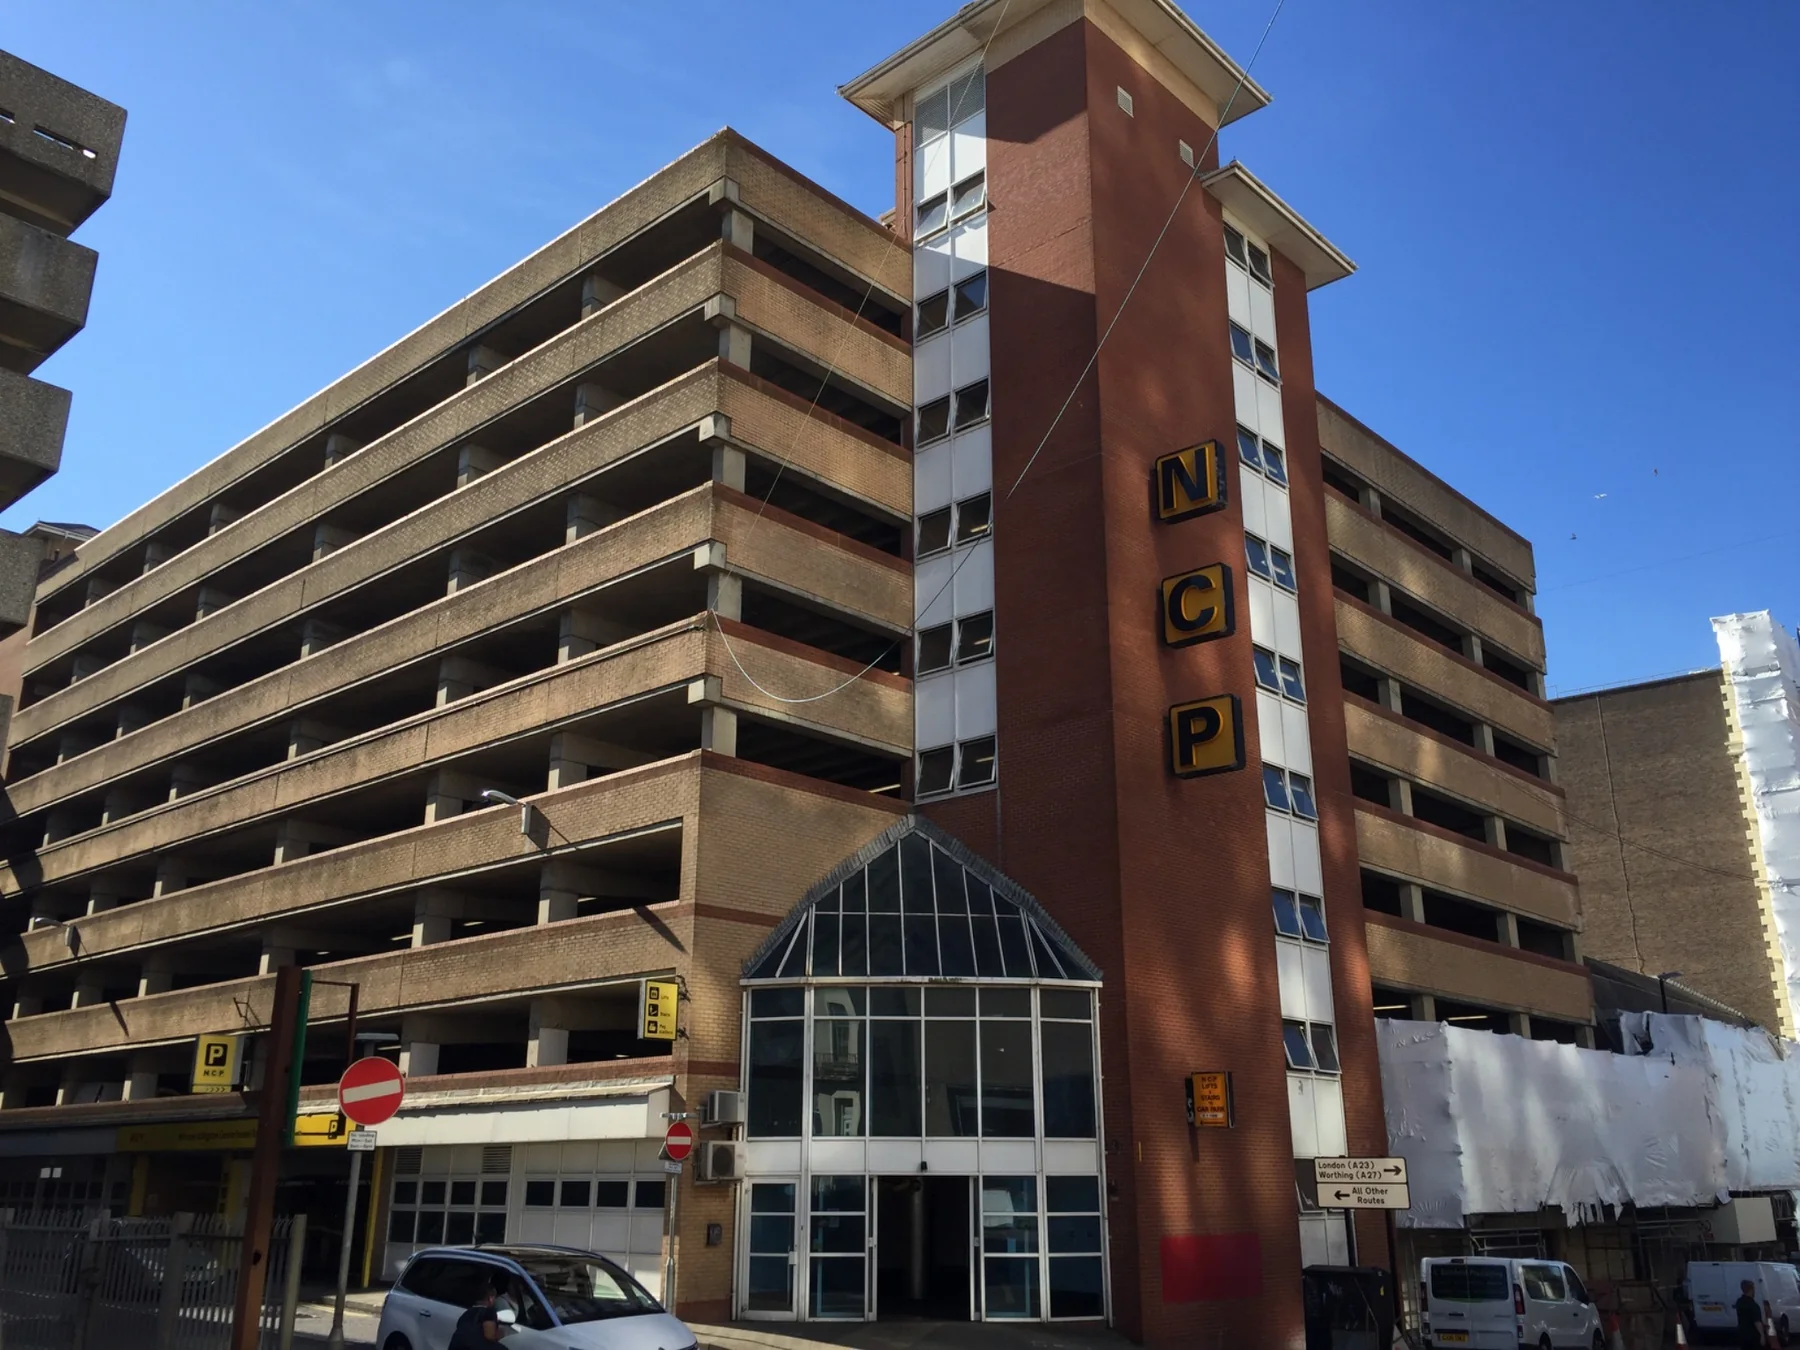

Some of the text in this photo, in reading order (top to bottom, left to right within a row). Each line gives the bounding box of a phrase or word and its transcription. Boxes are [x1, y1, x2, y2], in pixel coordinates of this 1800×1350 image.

[208, 1045, 224, 1065] P
[1318, 1160, 1375, 1170] London (A23)
[1318, 1170, 1382, 1180] Worthing (A27)
[1352, 1187, 1389, 1195] All Other
[1357, 1196, 1385, 1205] Routes
